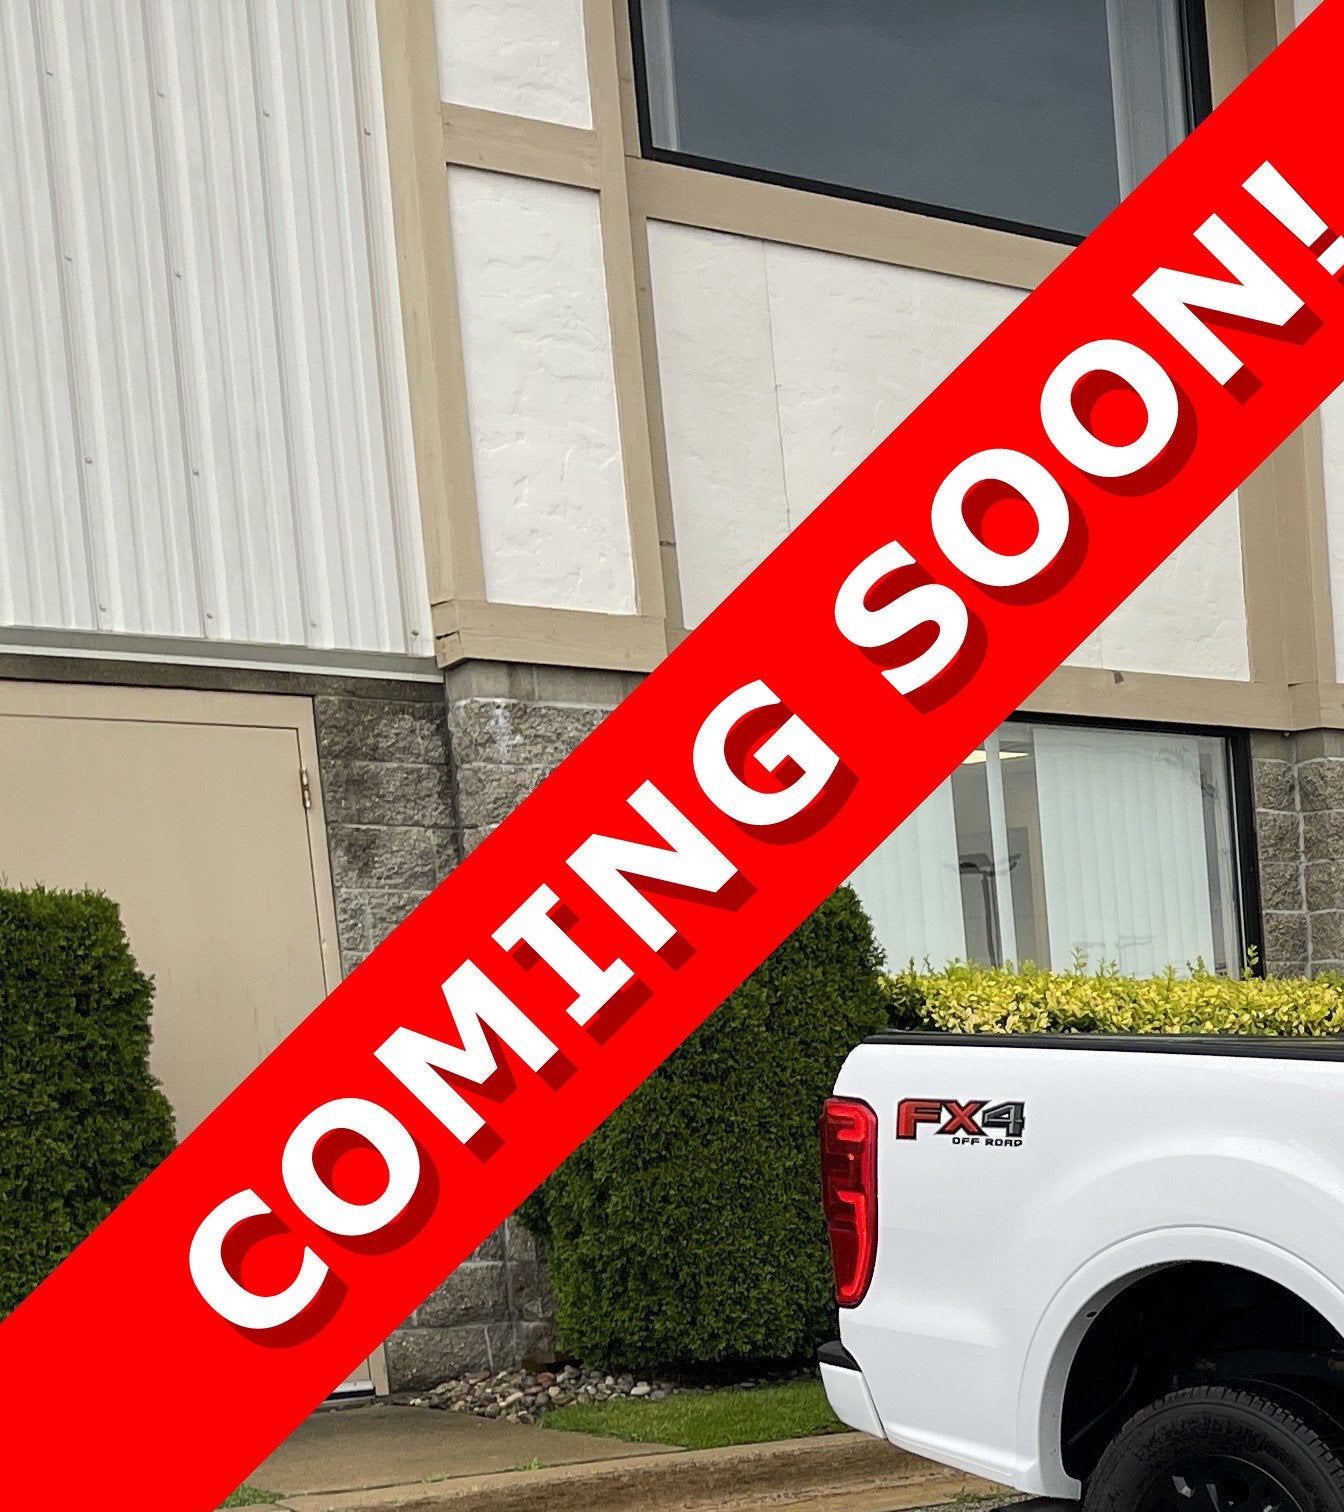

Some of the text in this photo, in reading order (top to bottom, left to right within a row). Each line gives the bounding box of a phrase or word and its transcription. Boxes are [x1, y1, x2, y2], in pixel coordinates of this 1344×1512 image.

[896, 1098, 1025, 1140] FX4
[952, 1136, 1023, 1148] OFF ROAD
